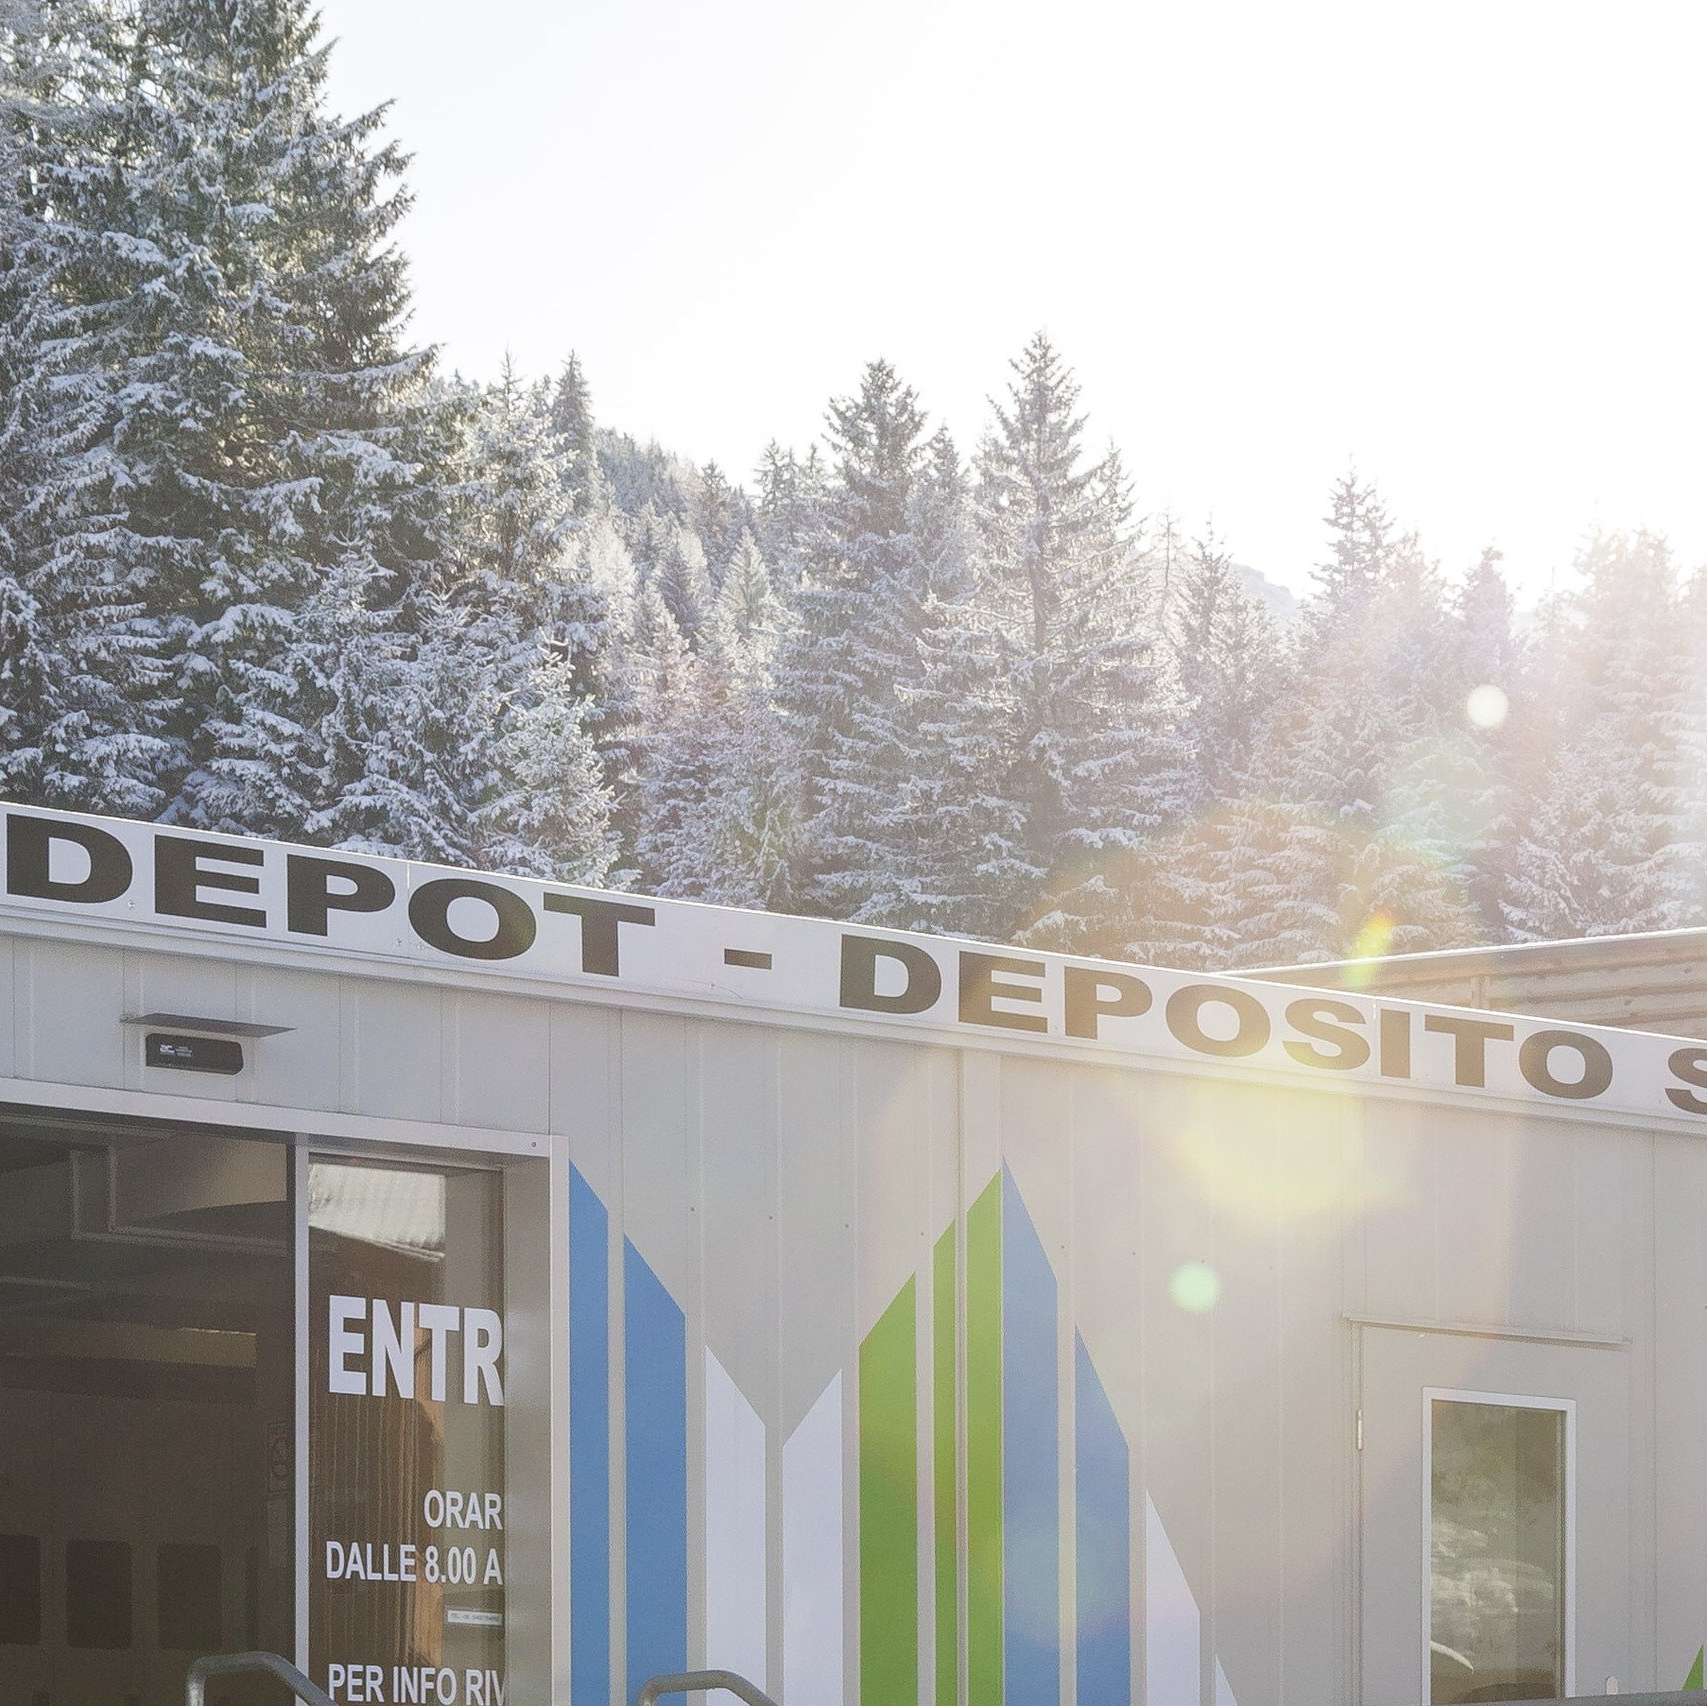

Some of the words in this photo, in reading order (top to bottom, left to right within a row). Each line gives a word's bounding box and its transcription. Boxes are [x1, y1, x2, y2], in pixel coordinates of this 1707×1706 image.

[6, 813, 656, 977] DEPOT
[838, 933, 1614, 1101] DEPOSITO
[329, 1294, 505, 1406] ENTR
[423, 1489, 504, 1531] ORAR
[326, 1541, 417, 1583] DALLE
[425, 1546, 476, 1585] 8.00
[328, 1663, 385, 1703] PER
[392, 1666, 457, 1706] INFO
